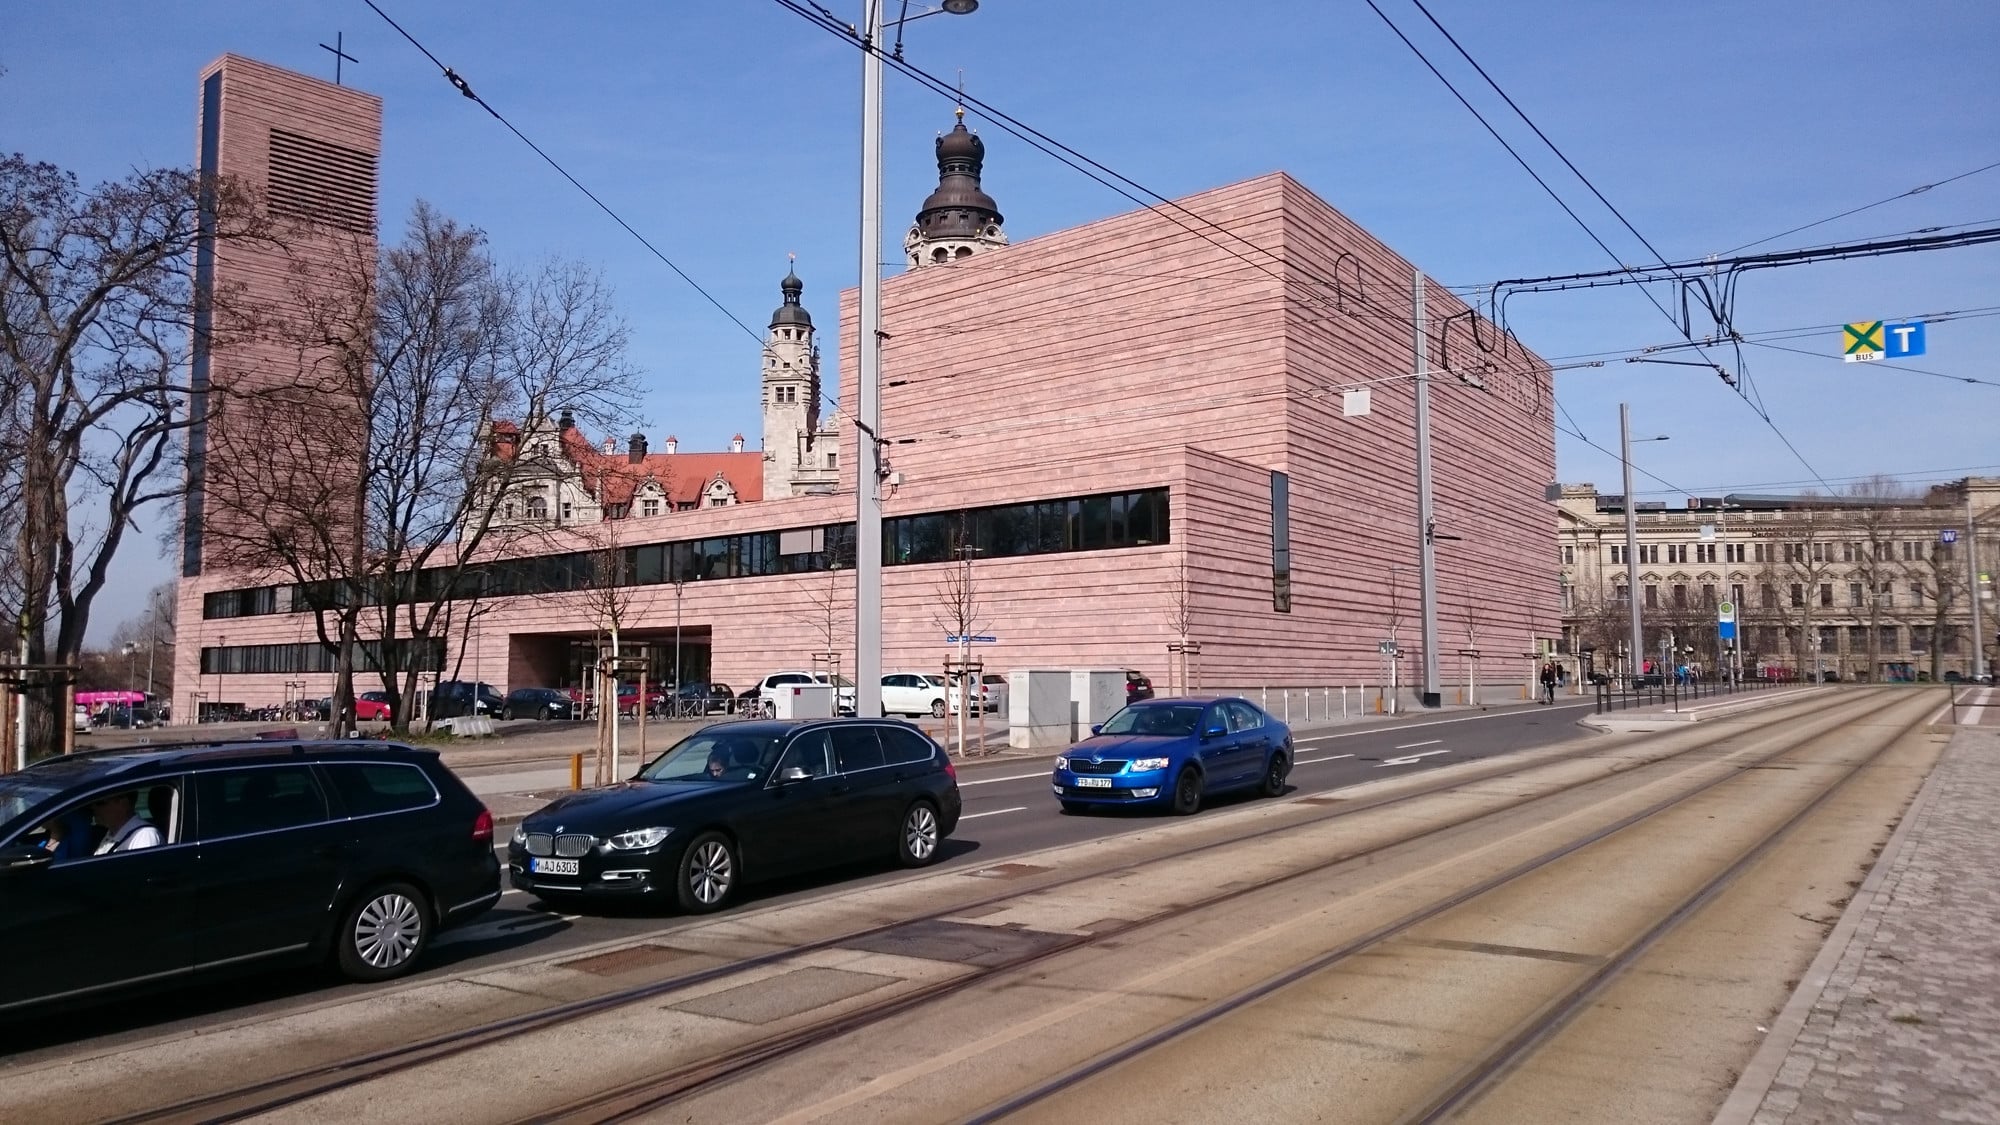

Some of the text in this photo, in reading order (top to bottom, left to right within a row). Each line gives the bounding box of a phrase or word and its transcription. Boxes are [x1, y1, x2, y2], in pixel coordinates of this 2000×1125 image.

[1893, 327, 1916, 353] T
[1855, 353, 1874, 361] BUS
[1943, 532, 1955, 541] W
[545, 861, 555, 872] AJ
[556, 861, 577, 873] 6303
